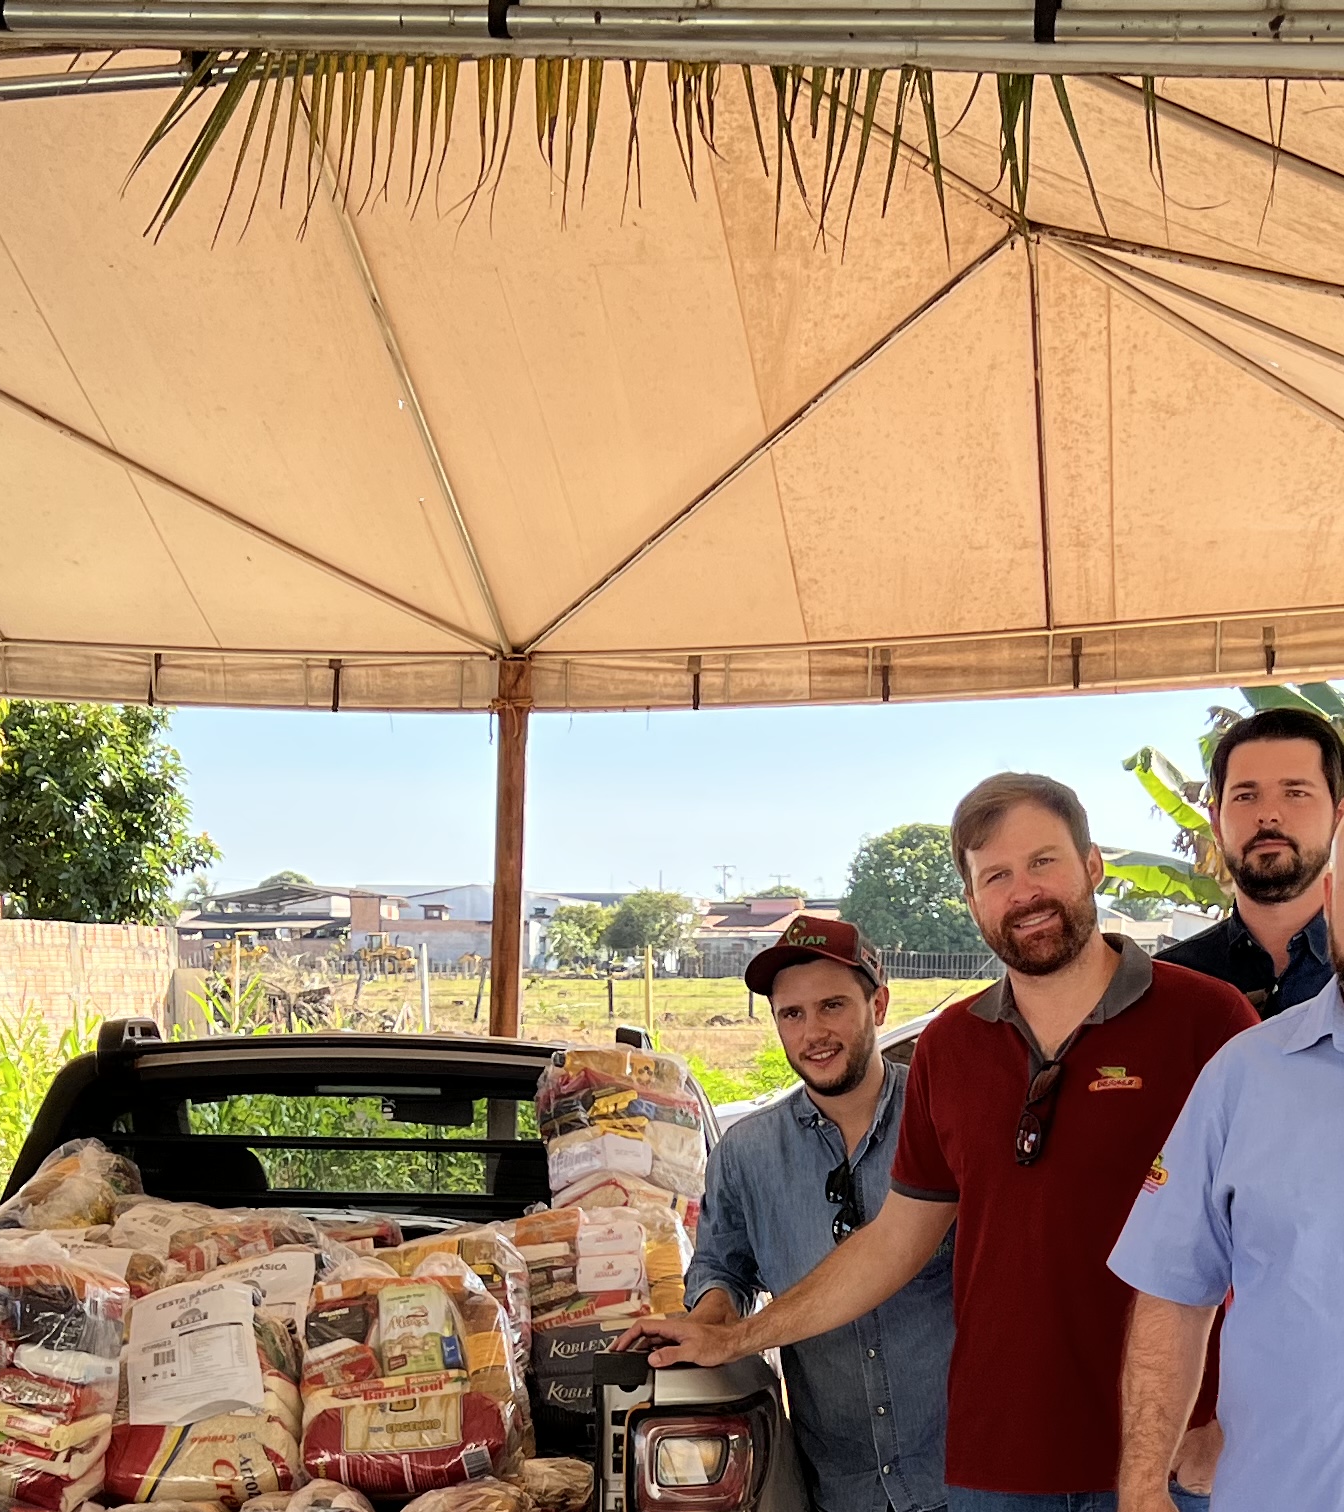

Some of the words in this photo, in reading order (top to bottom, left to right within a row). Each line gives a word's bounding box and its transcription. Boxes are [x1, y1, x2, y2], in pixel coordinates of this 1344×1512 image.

[156, 1296, 187, 1311] CESTA
[361, 1380, 444, 1401] Barralcool
[547, 1380, 594, 1406] KOBLE
[385, 1418, 442, 1434] ENGENHO
